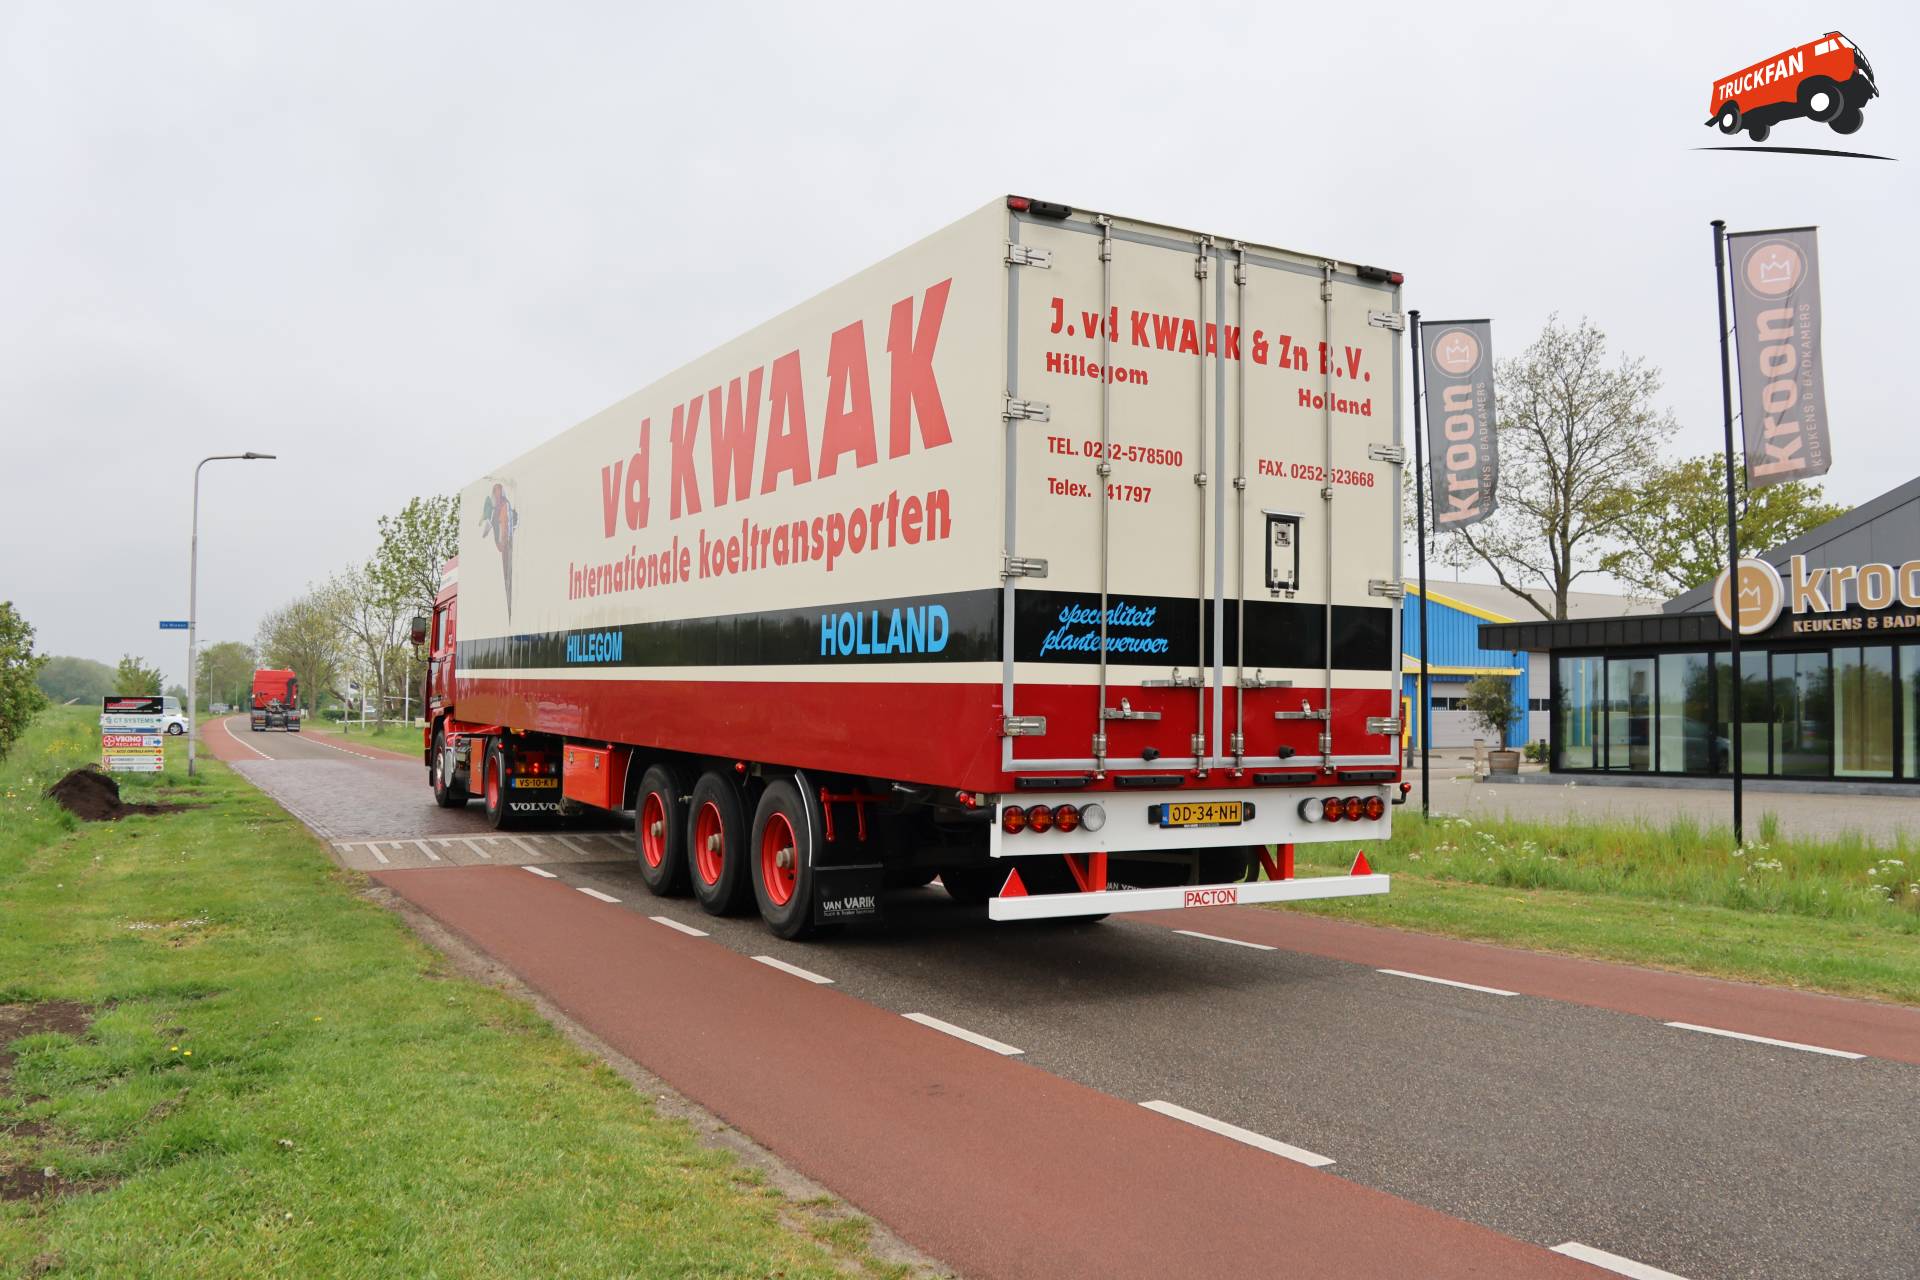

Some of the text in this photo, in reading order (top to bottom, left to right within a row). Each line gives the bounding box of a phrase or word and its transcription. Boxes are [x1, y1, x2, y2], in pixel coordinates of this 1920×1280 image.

[1251, 329, 1269, 365] &
[1279, 335, 1309, 372] Zn
[1799, 303, 1814, 387] BADKAMERS
[1046, 351, 1149, 386] Hillegom
[601, 277, 953, 538] vd KWAAK
[1298, 388, 1372, 417] Holland
[1754, 307, 1806, 477] kroon
[1047, 436, 1079, 456] TEL.
[1803, 405, 1822, 467] KEUKENS
[1258, 459, 1287, 477] FAX.
[1439, 383, 1480, 523] kroon
[1047, 478, 1092, 498] Telex.
[569, 488, 952, 600] Internationale koeltransporten
[820, 604, 950, 656] HOLLAND
[1793, 615, 1920, 632] KEUKENS & BAD
[567, 631, 623, 663] HILLEGOM
[509, 802, 560, 811] VOLVO
[1173, 805, 1238, 822] OD-34-NH
[823, 896, 875, 910] VAN VARIK
[1186, 890, 1236, 906] PACTON
